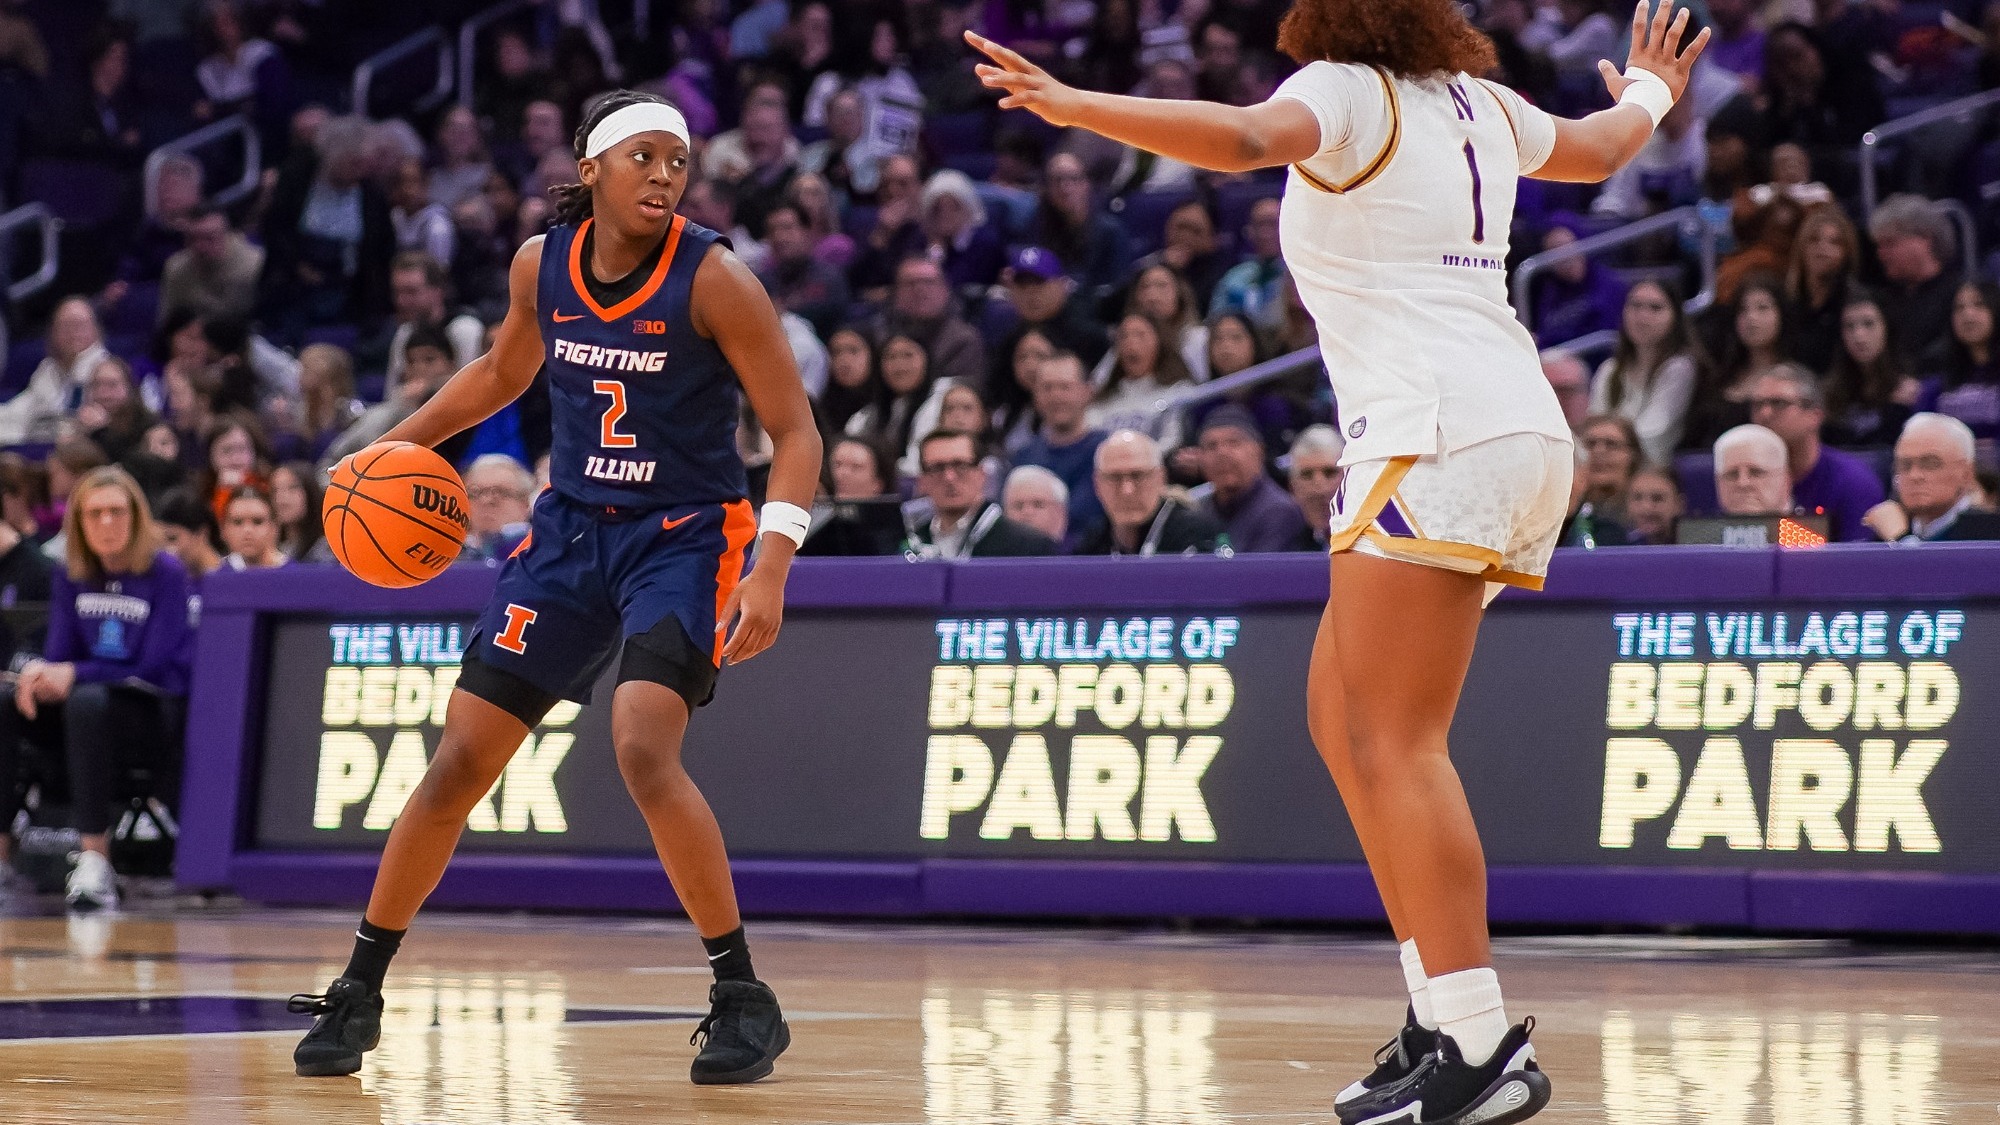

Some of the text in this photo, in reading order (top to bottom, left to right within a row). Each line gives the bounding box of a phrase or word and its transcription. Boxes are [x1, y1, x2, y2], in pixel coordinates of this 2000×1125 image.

[1446, 82, 1474, 121] N
[1462, 137, 1484, 245] 1
[554, 338, 668, 372] FIGHTING
[593, 379, 637, 447] 2
[584, 455, 656, 482] ILLINI
[412, 484, 470, 532] Wilso
[329, 623, 464, 663] THE VILL
[493, 603, 538, 655] I
[935, 617, 1241, 660] THE VILLAGE OF
[1613, 610, 1966, 657] THE VILLAGE OF
[928, 664, 1235, 729] BEDFORD
[1605, 660, 1961, 730] BEDFORD
[920, 732, 1225, 842] PARK
[1599, 736, 1949, 852] PARK
